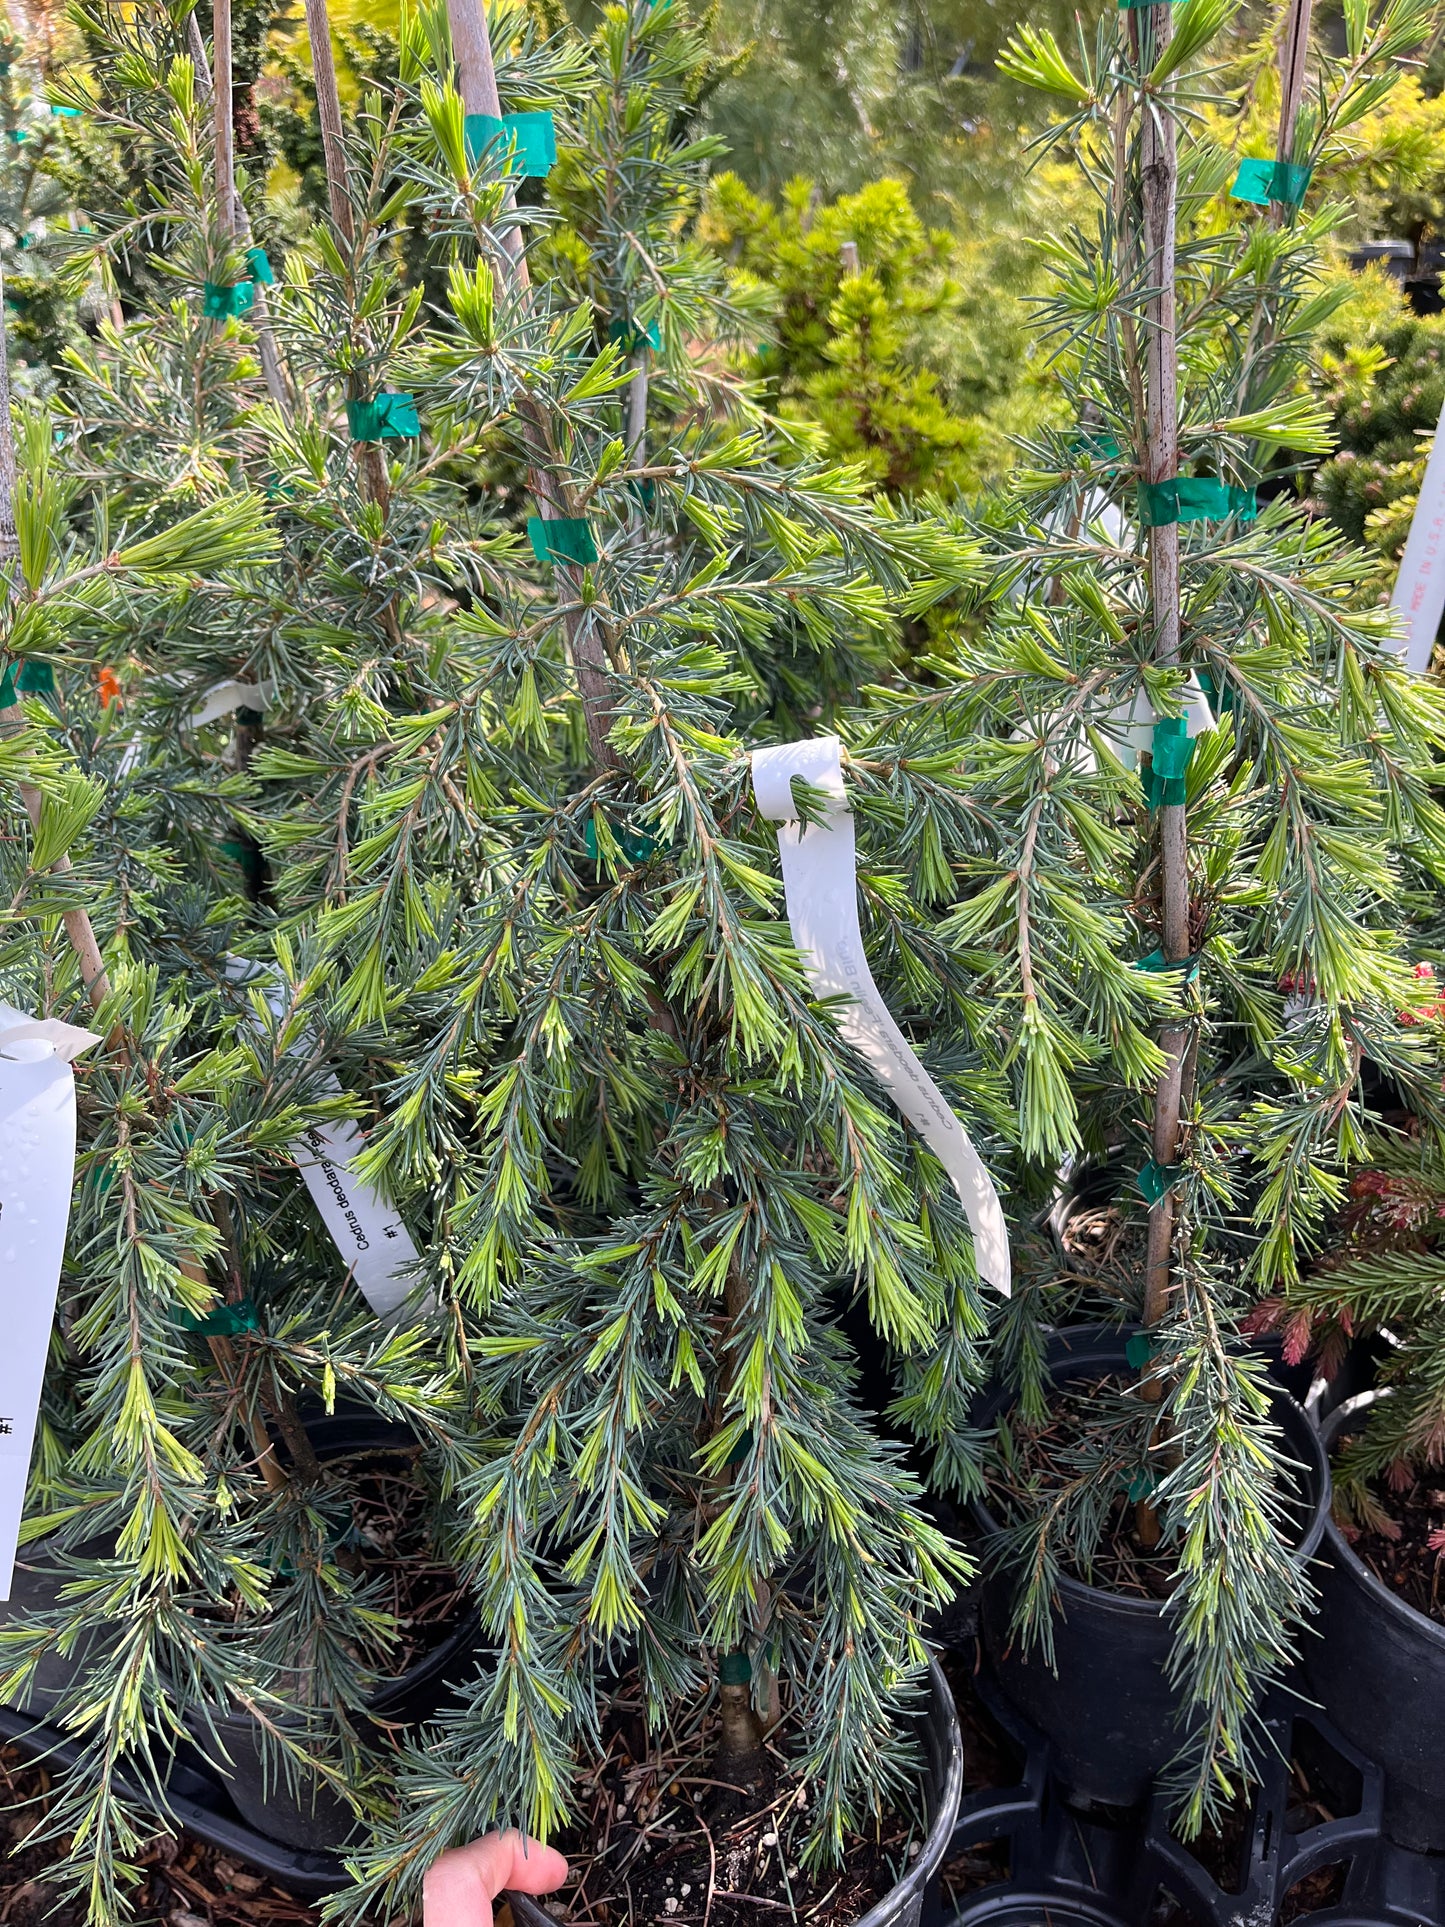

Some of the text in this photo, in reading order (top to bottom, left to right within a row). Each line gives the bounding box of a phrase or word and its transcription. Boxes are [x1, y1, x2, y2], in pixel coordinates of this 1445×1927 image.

[1419, 560, 1432, 575] IN
[320, 1161, 350, 1210] deodara
[345, 1210, 370, 1251] Cedrus
[382, 1224, 398, 1239] #1
